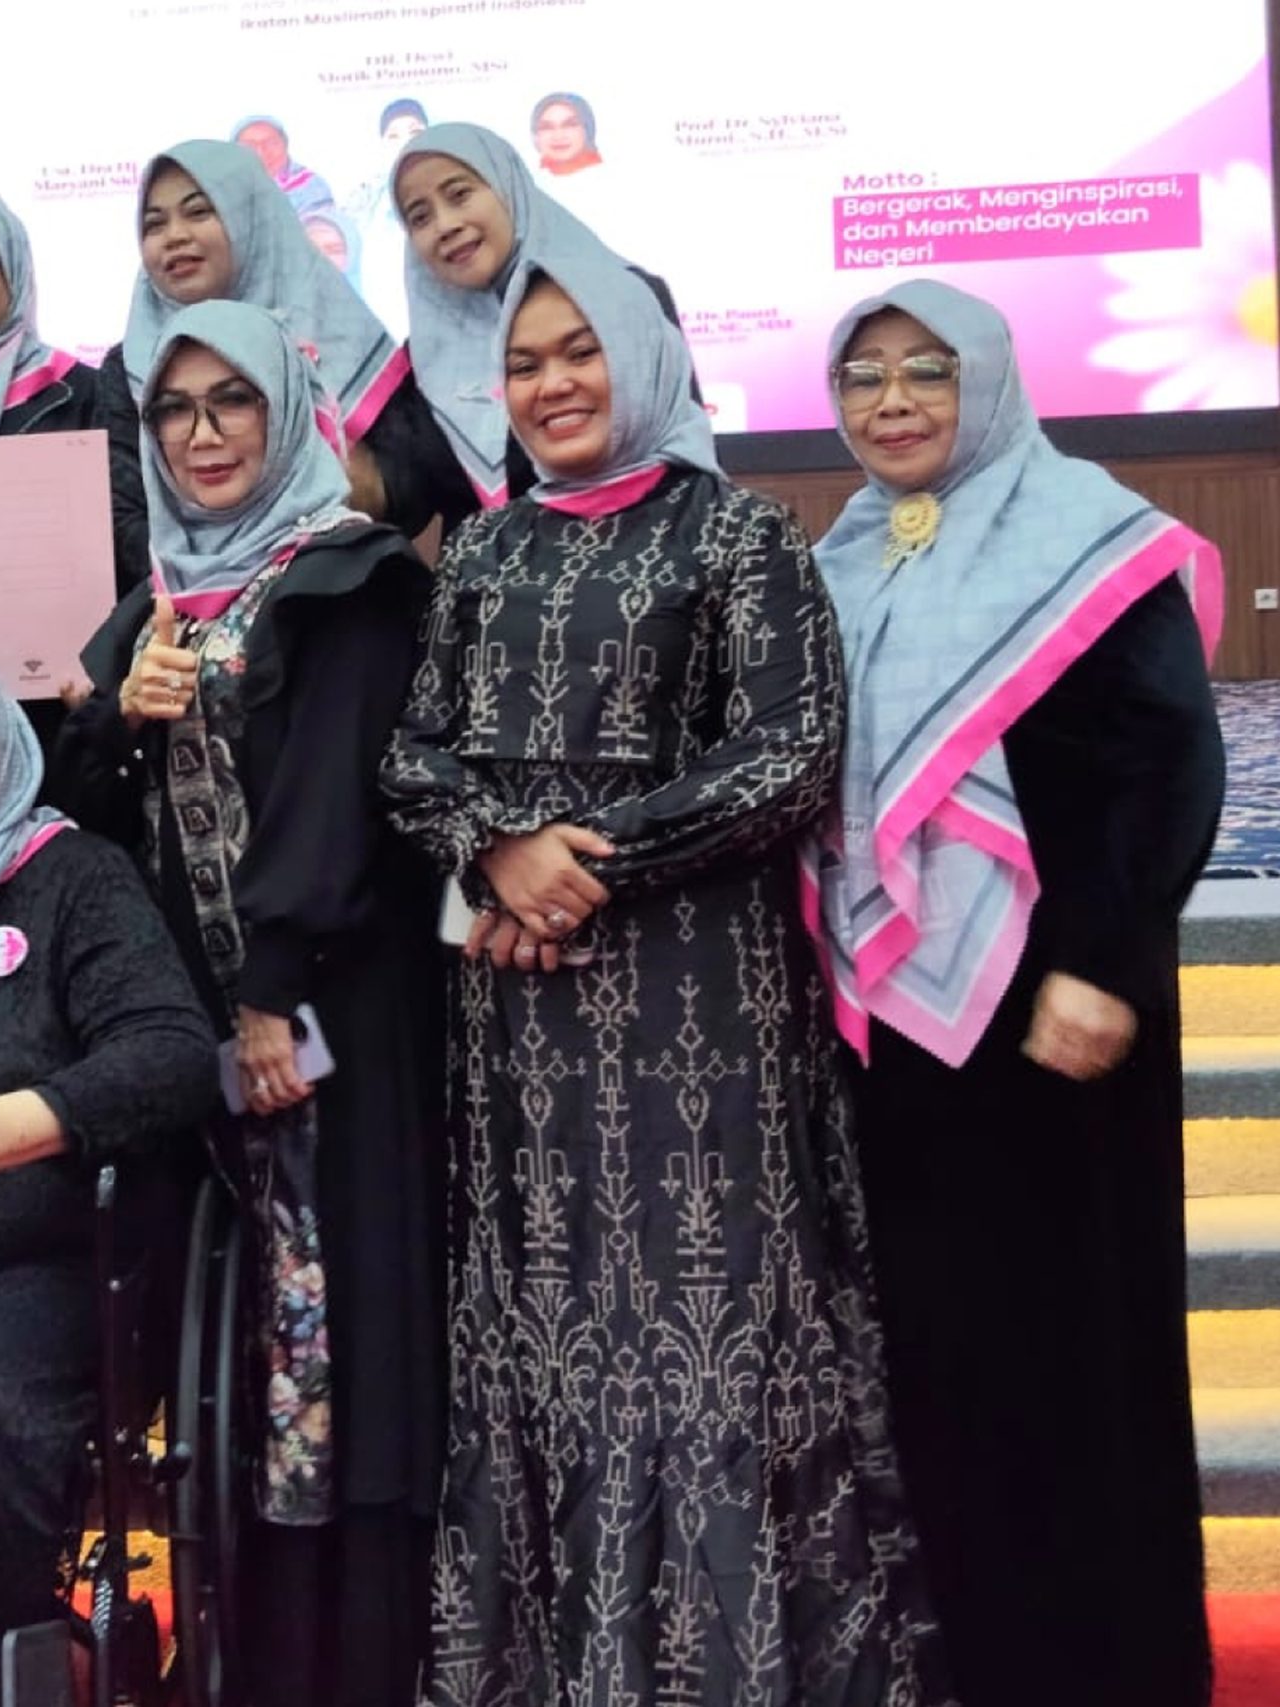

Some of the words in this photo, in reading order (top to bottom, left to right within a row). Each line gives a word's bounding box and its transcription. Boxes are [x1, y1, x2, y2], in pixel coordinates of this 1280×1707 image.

[304, 9, 397, 26] Muslimah
[842, 171, 924, 191] Motto
[842, 189, 973, 220] Bergerak,
[979, 178, 1184, 211] Menginspirasi,
[843, 219, 898, 243] dan
[906, 204, 1150, 239] Memberdayakan
[843, 241, 934, 269] Negeri
